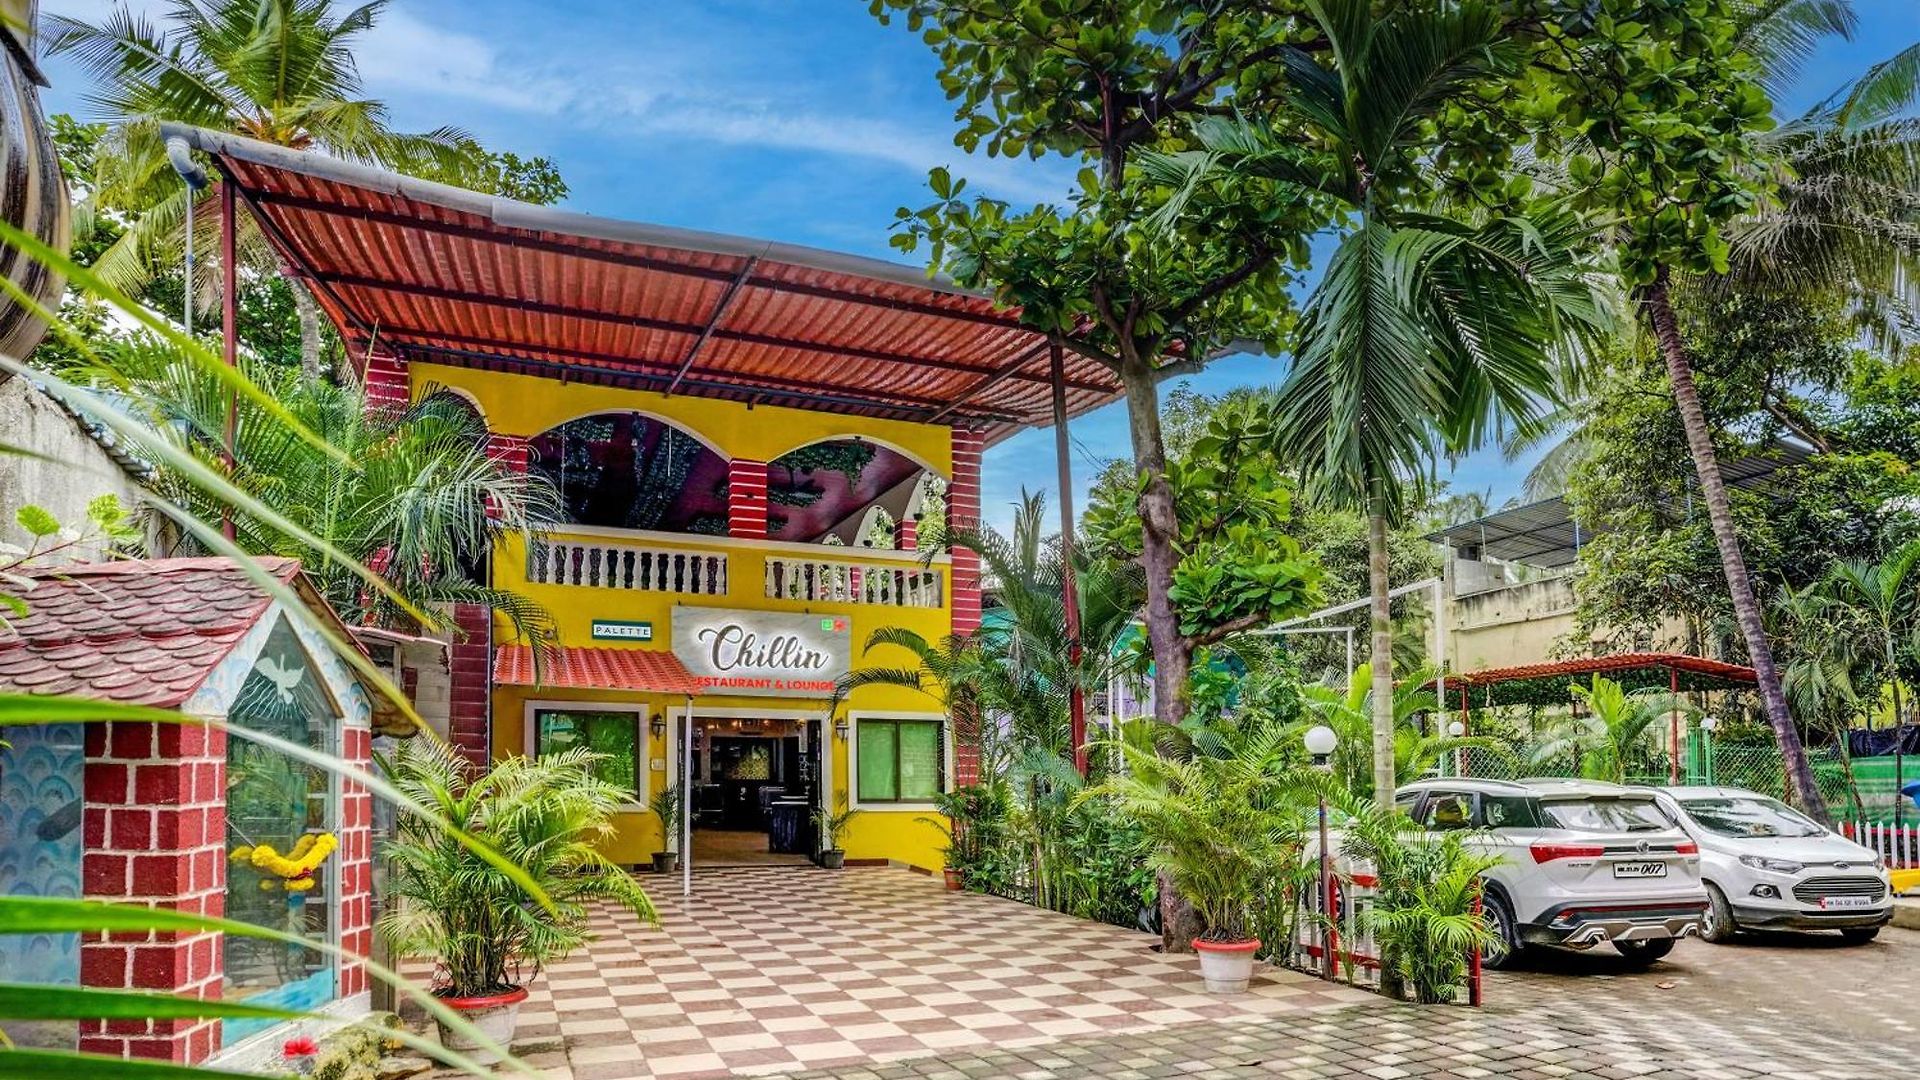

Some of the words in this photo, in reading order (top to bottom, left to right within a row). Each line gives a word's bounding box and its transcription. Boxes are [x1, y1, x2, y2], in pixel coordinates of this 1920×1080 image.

[595, 626, 650, 636] PALETTE
[698, 624, 828, 671] Chillin
[693, 676, 771, 688] ESTAURANT
[775, 679, 784, 689] &
[1640, 863, 1663, 875] 007
